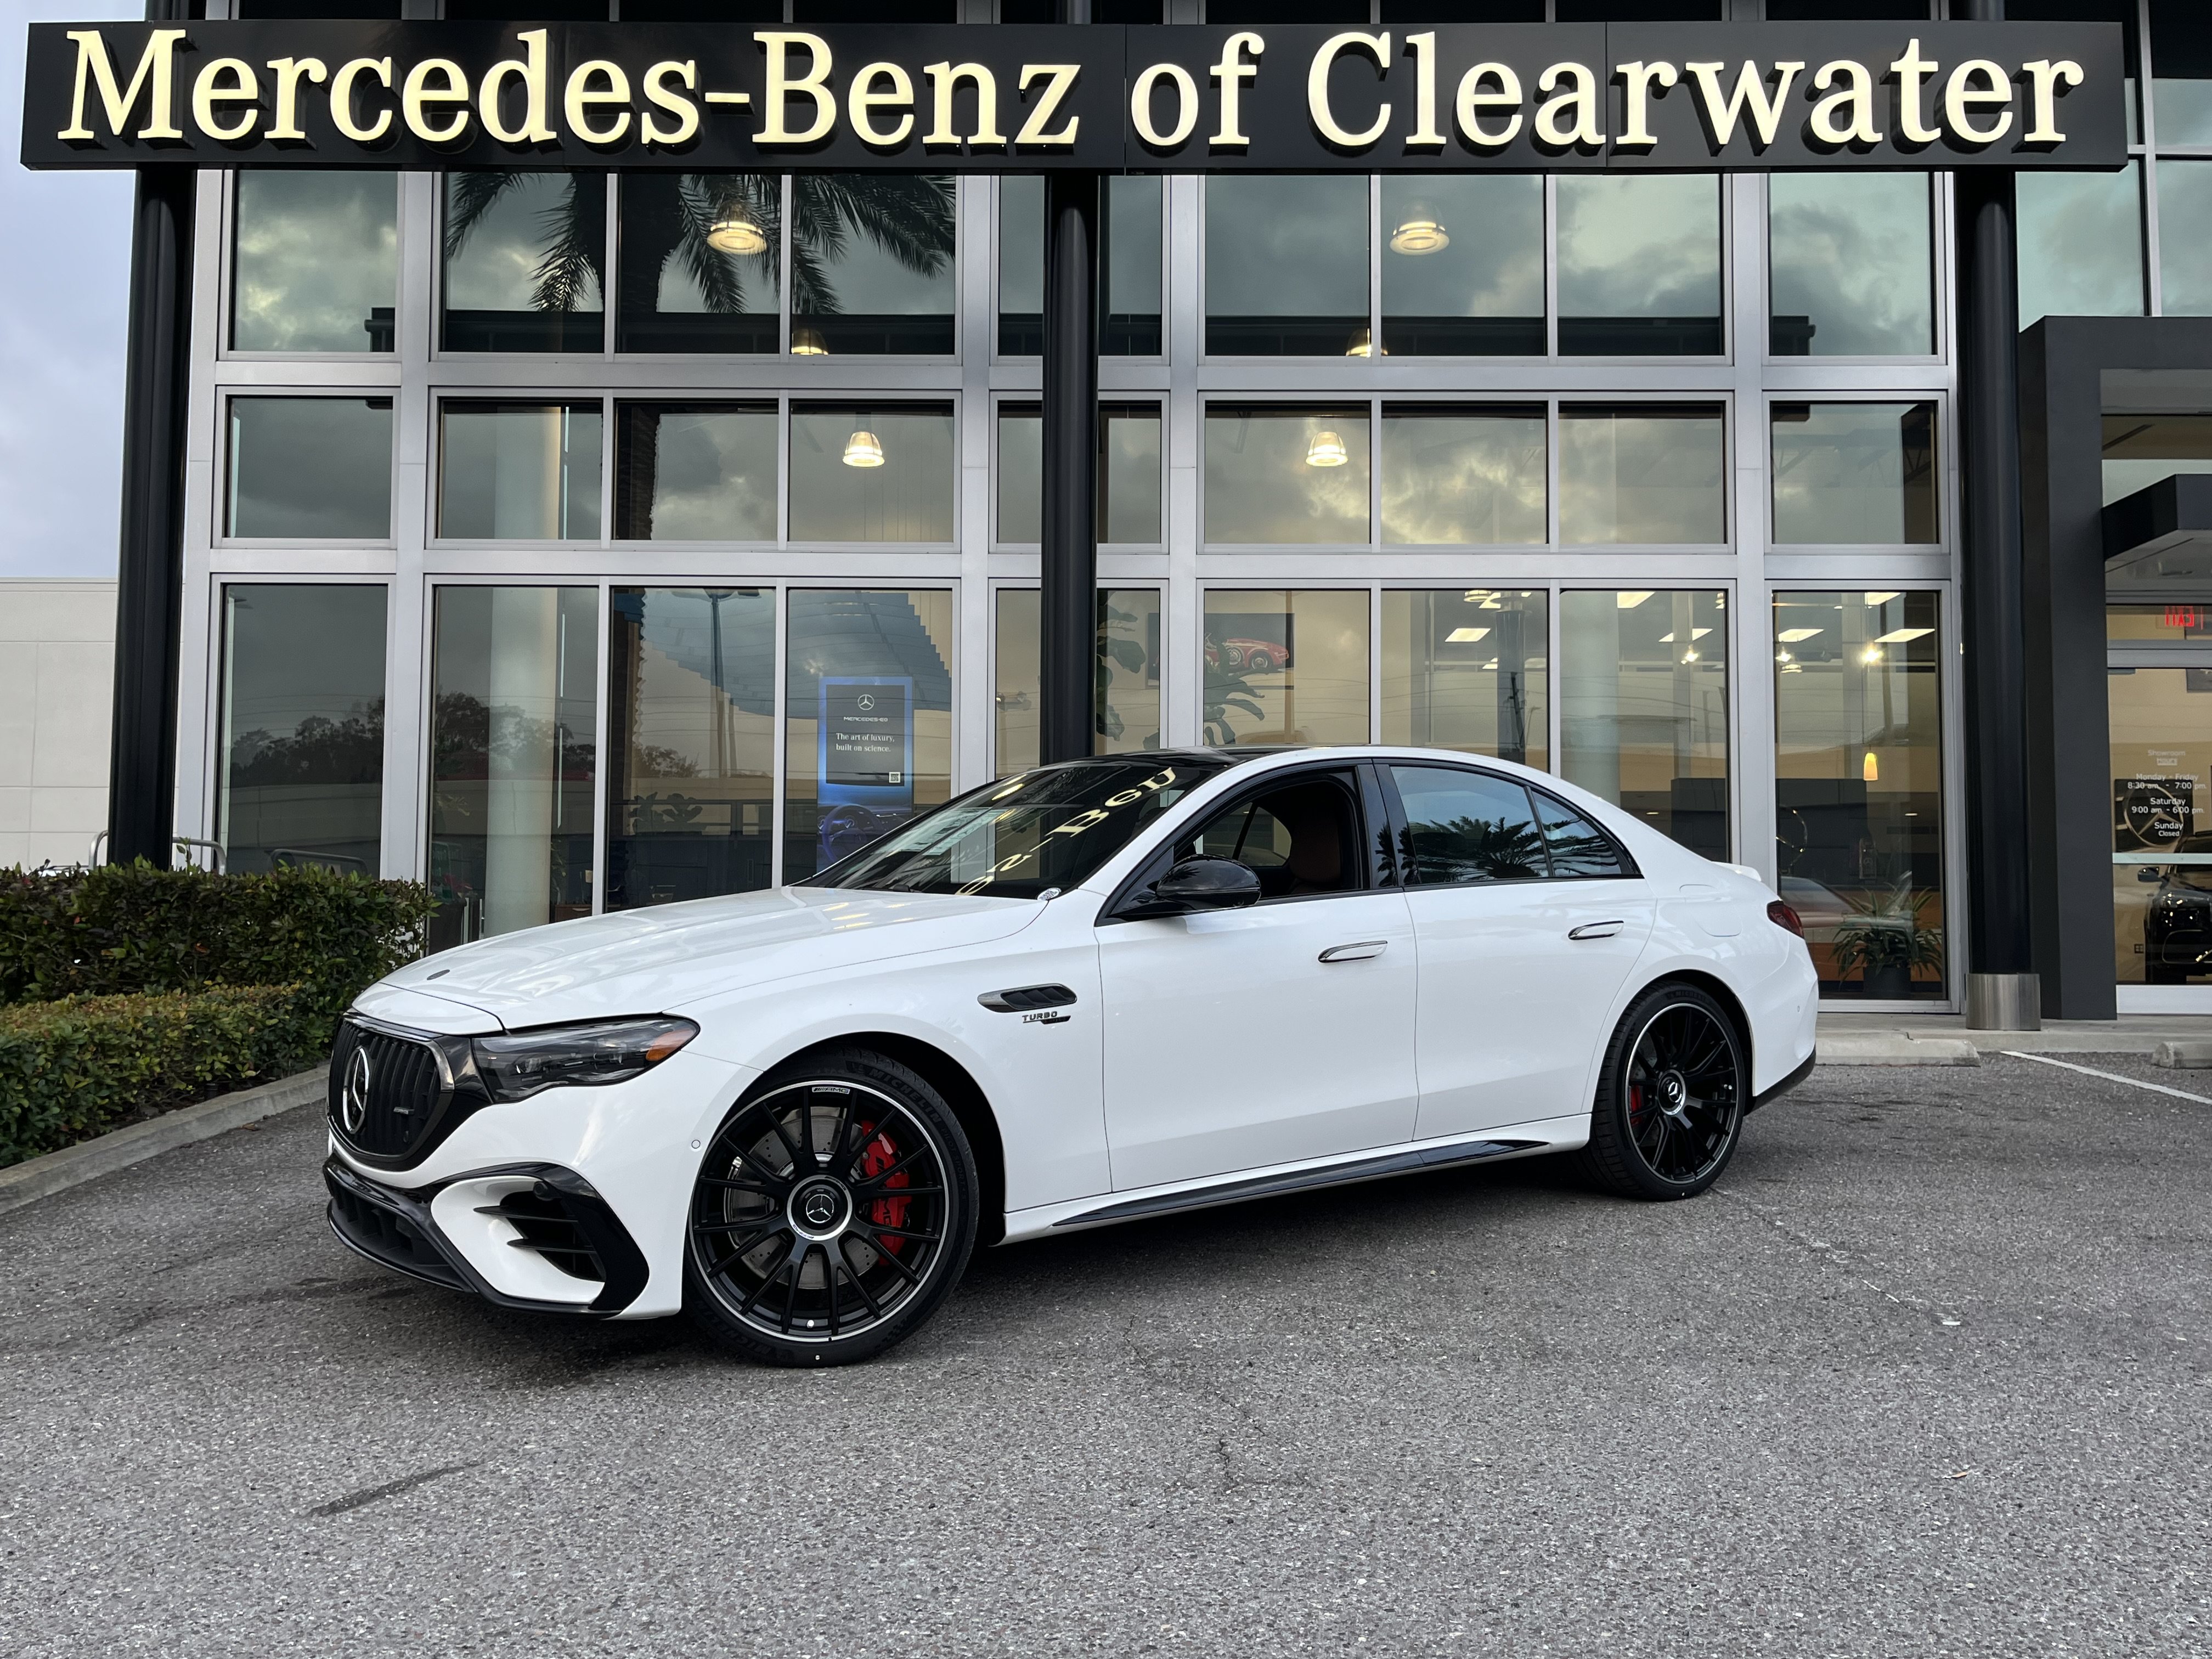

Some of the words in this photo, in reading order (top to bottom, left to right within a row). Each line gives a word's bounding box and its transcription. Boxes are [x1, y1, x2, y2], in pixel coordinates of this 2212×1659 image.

[57, 28, 1081, 145] Mercedes-Benz
[1131, 31, 1265, 146] of
[1307, 31, 2084, 146] Clearwater
[871, 734, 895, 742] luxury,
[836, 743, 851, 751] built
[1022, 1011, 1058, 1022] TURBO
[868, 1067, 943, 1124] MICHELIN
